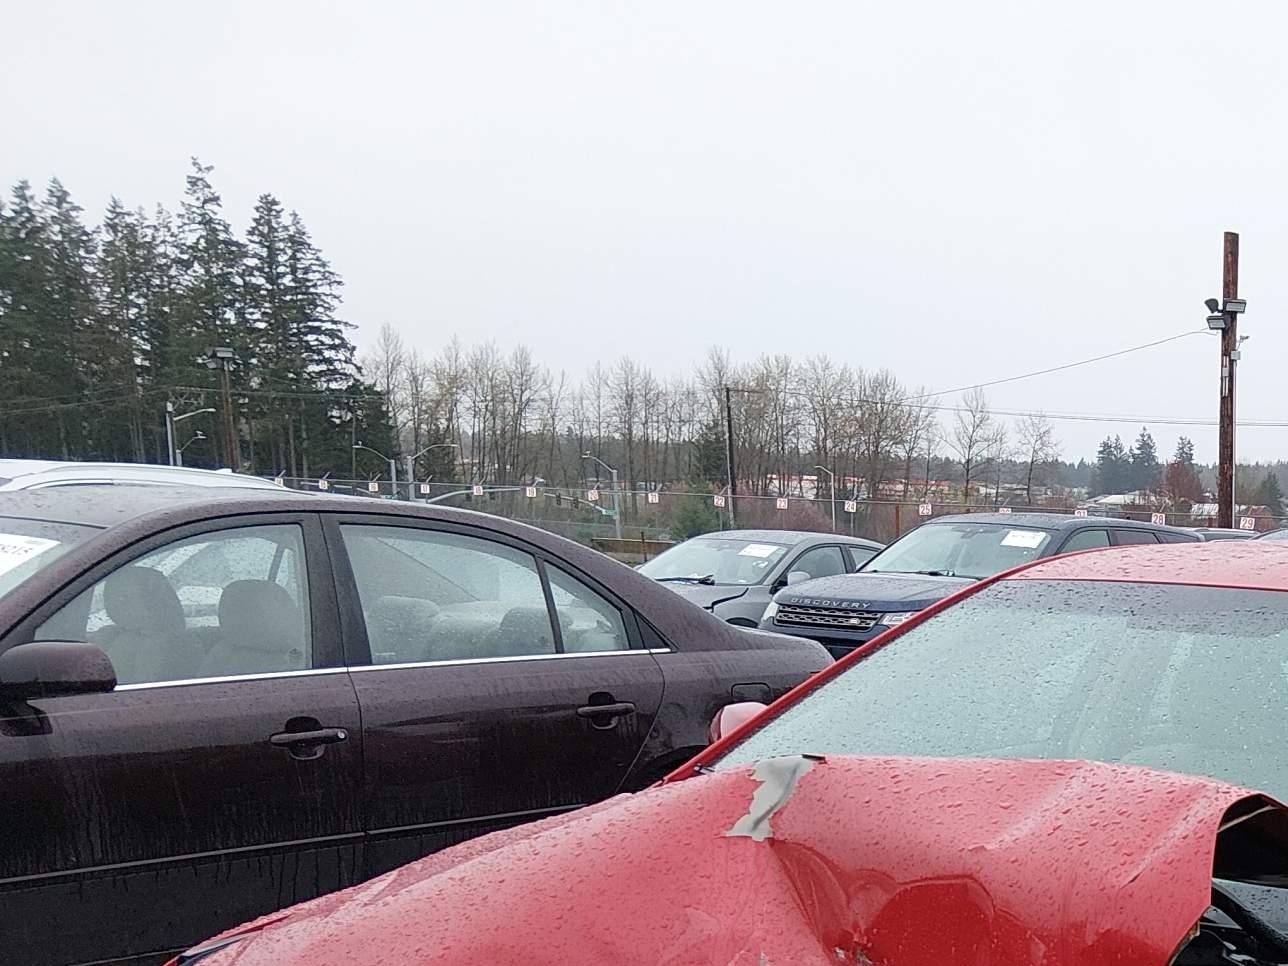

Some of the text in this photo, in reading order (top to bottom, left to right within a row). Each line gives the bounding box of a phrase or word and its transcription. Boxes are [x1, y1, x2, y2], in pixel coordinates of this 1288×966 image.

[846, 500, 856, 511] 24
[920, 504, 931, 515] 25
[1153, 513, 1164, 525] 28
[1241, 517, 1254, 529] 29
[790, 597, 871, 609] DISCOVERY
